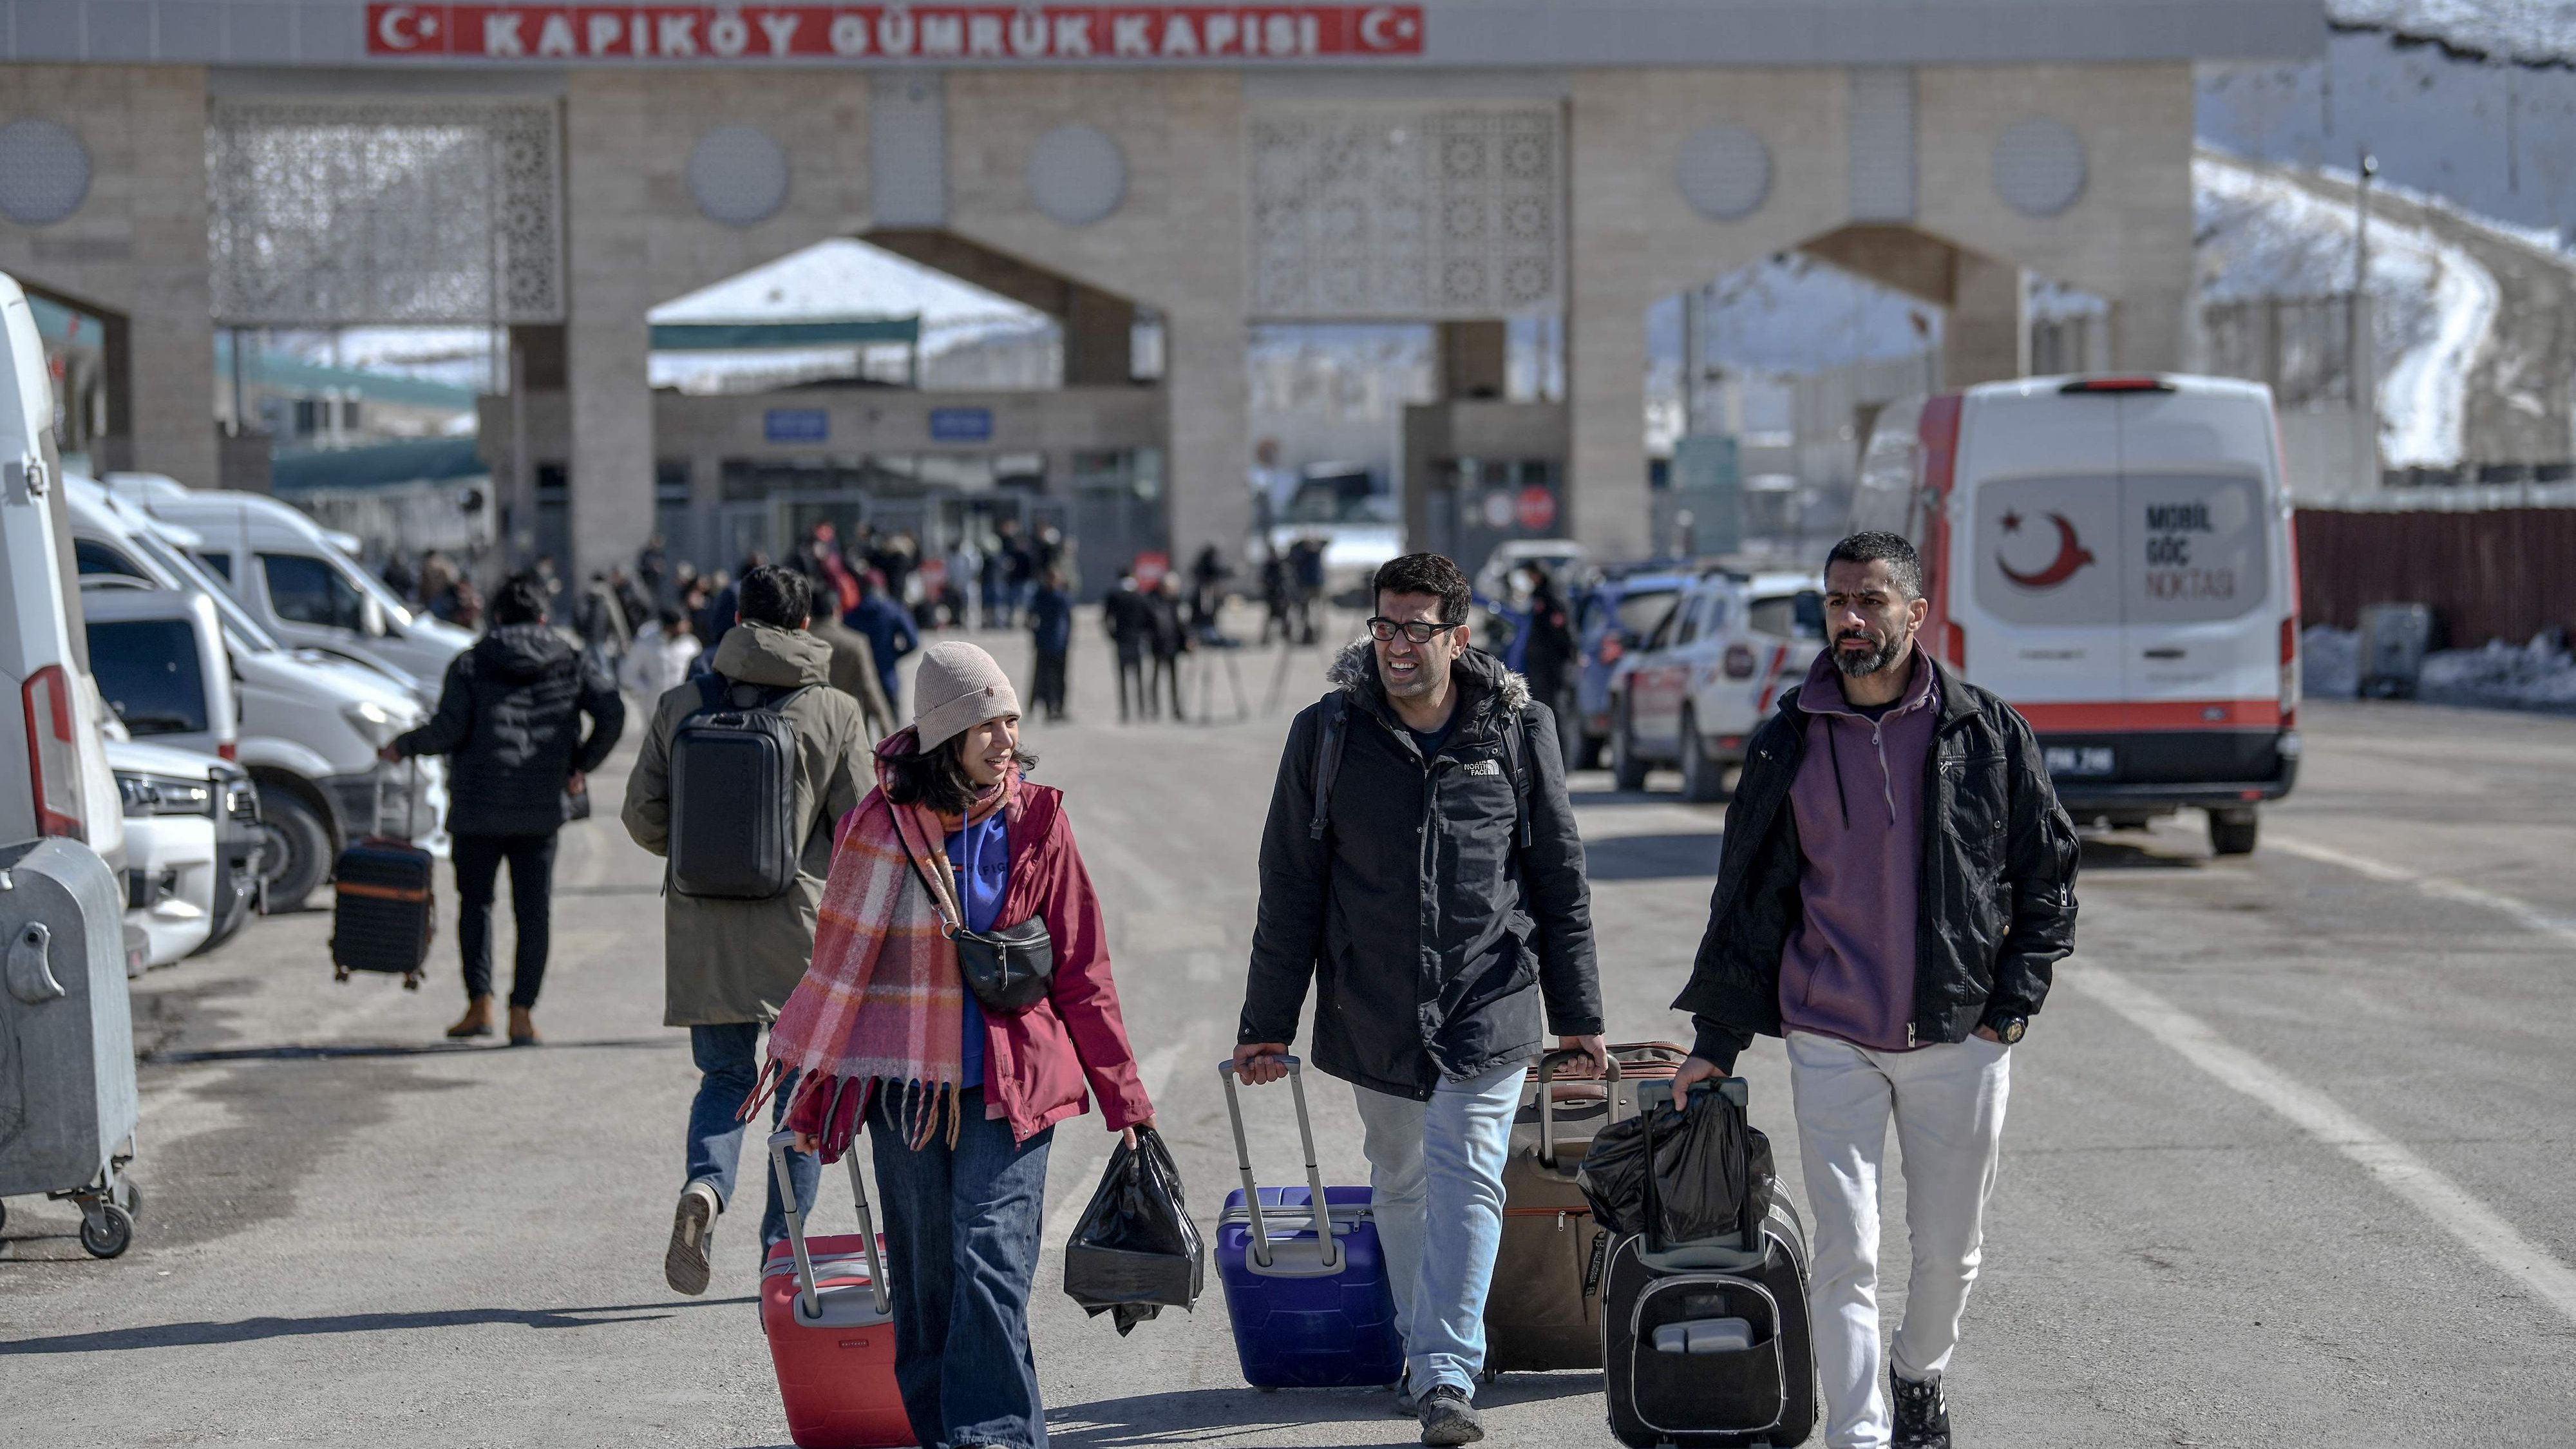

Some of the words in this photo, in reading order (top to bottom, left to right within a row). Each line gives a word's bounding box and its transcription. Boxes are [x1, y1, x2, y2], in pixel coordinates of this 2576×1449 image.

[483, 5, 801, 58] KAPIKÖY
[828, 6, 1094, 57] GÜMRÜK
[1112, 14, 1320, 55] KAPISI
[2146, 499, 2214, 533] MOBİL
[2146, 536, 2190, 567] GÖÇ
[2145, 569, 2237, 601] NOKTASI
